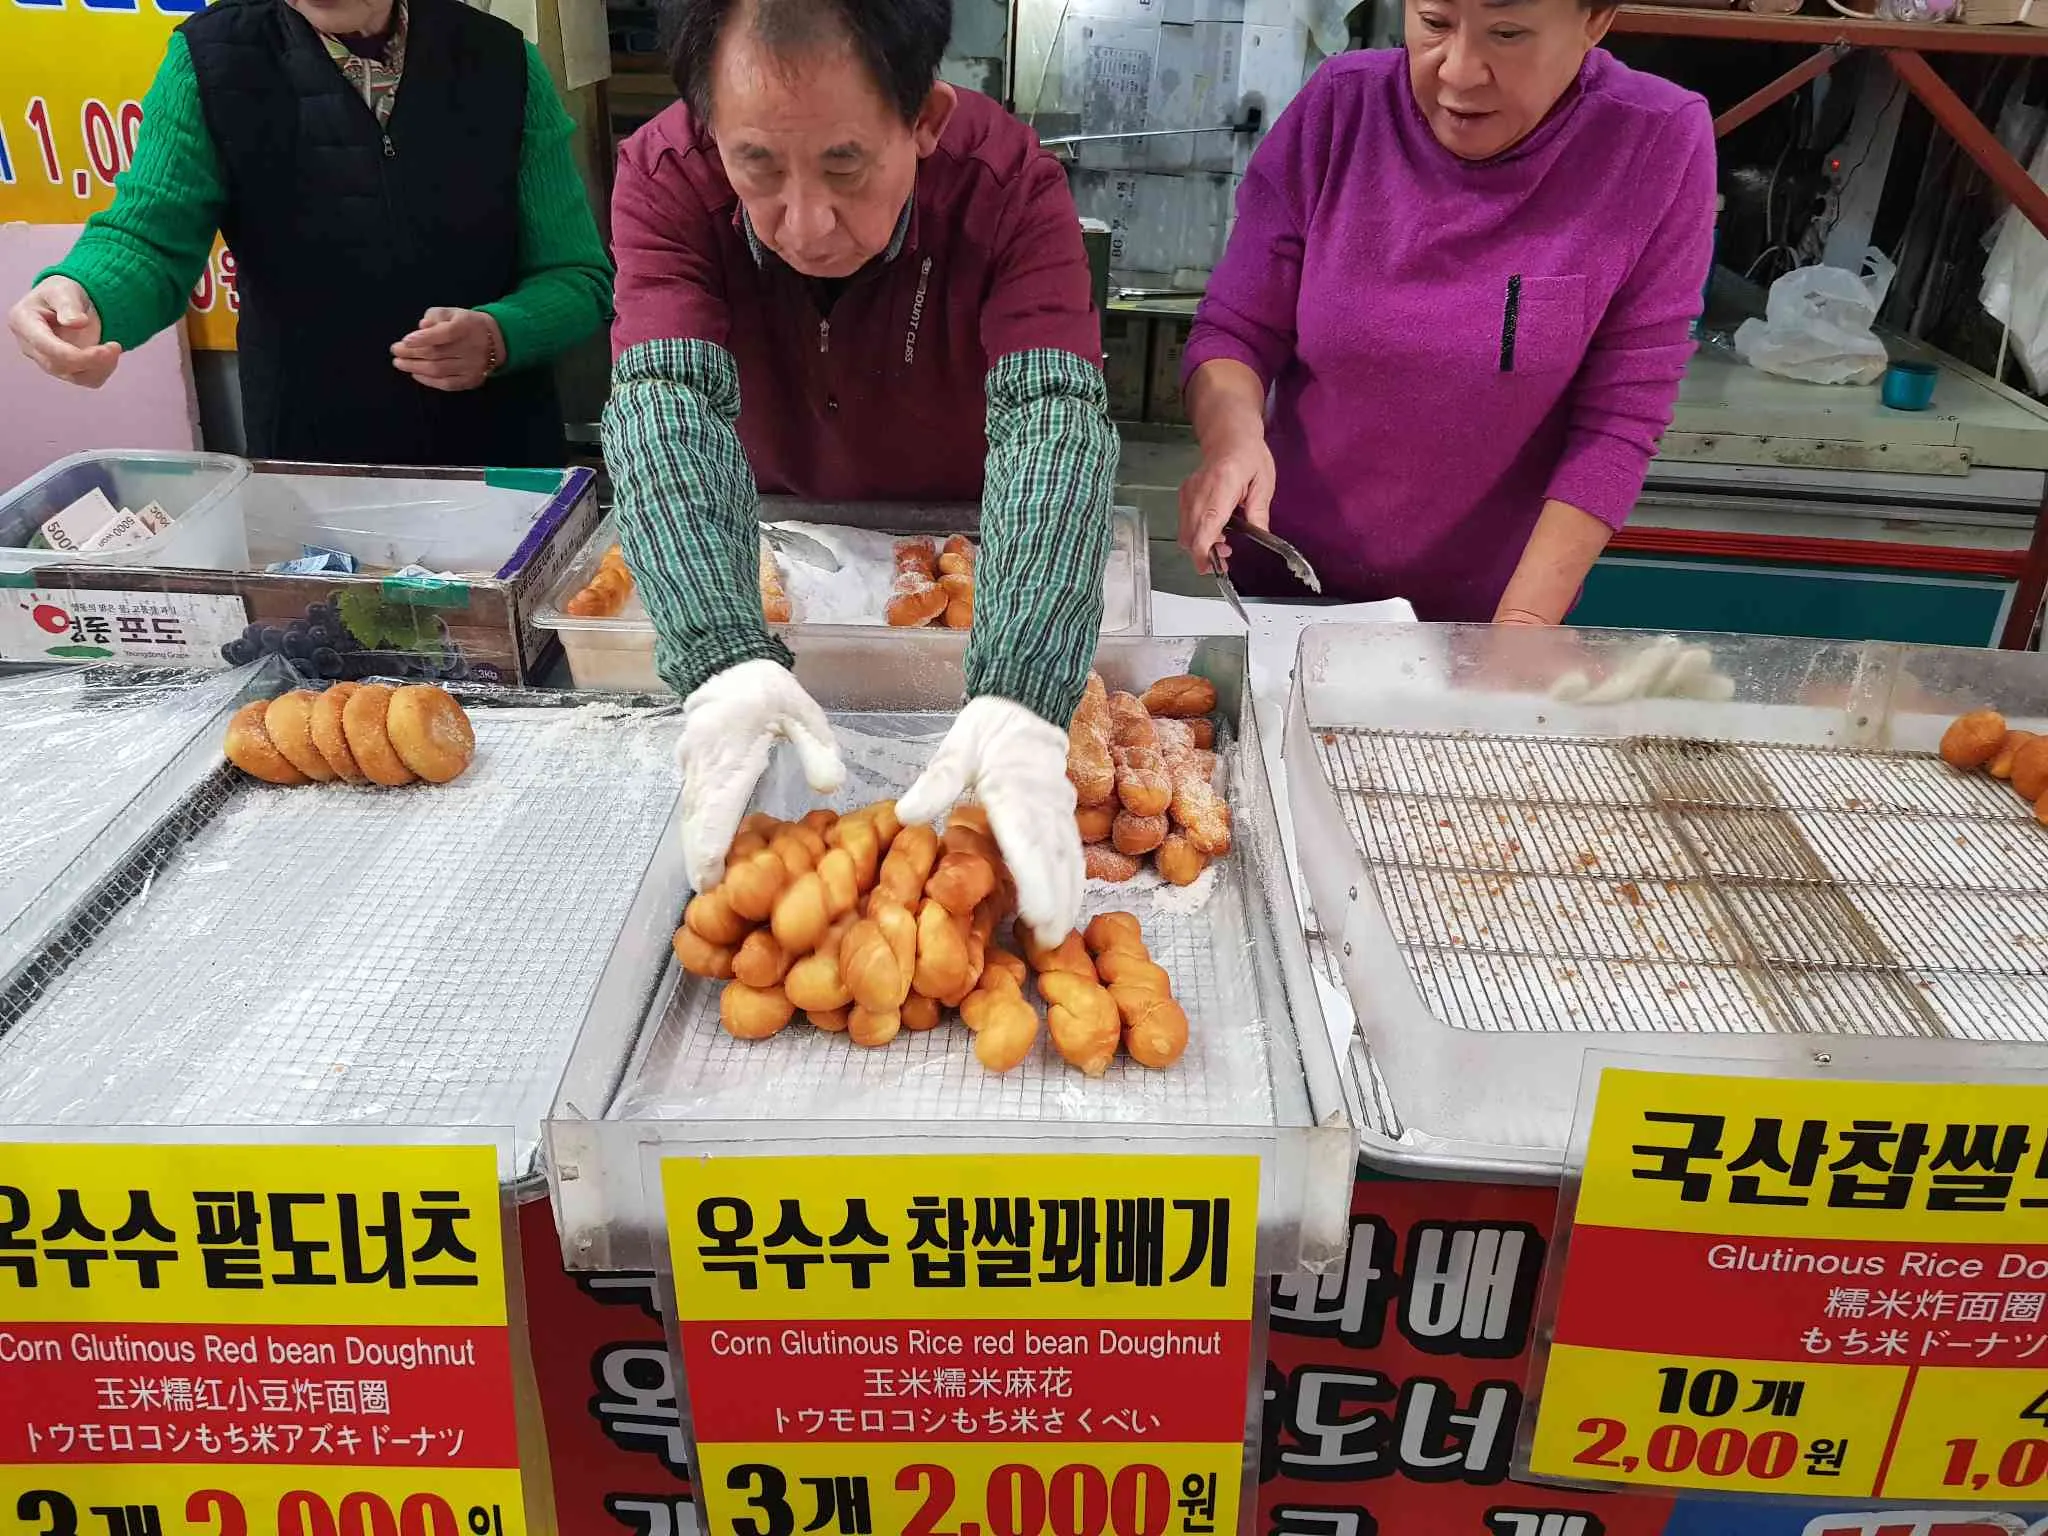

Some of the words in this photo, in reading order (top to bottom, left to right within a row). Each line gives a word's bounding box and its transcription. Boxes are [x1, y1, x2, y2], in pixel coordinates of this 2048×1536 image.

[113, 516, 136, 537] 5000
[116, 616, 187, 644] 포도
[0, 1186, 179, 1288] 옥수수
[193, 1190, 479, 1289] 팥도너츠
[697, 1196, 890, 1290] 옥수수
[906, 1196, 1230, 1288] 찹쌀꽈배기
[1707, 1244, 1885, 1276] Glutinous
[1899, 1251, 1984, 1278] Rice
[1823, 1286, 2046, 1323] 糯米炸面圈
[0, 1333, 61, 1361] Corn
[71, 1333, 196, 1363] Glutinous
[204, 1335, 257, 1363] Red
[267, 1336, 336, 1364] bean
[345, 1336, 475, 1370] Doughnut
[711, 1330, 771, 1355] Corn
[781, 1329, 898, 1355] Glutinous
[908, 1329, 965, 1355] Rice
[974, 1330, 1014, 1355] red
[1025, 1330, 1088, 1355] bean
[1099, 1329, 1221, 1358] Doughnut
[1800, 1326, 2048, 1359] もち米ドーナツ
[95, 1376, 390, 1415] 玉米糯红小豆炸面圈
[864, 1366, 1073, 1398] 玉米糯米麻花
[1658, 1367, 1805, 1417] 10개
[776, 1407, 1160, 1434] トウモロコシもち米さくべい
[27, 1422, 464, 1456] トウモロコシもち米アズキドーナツ
[726, 1463, 873, 1535] 3개
